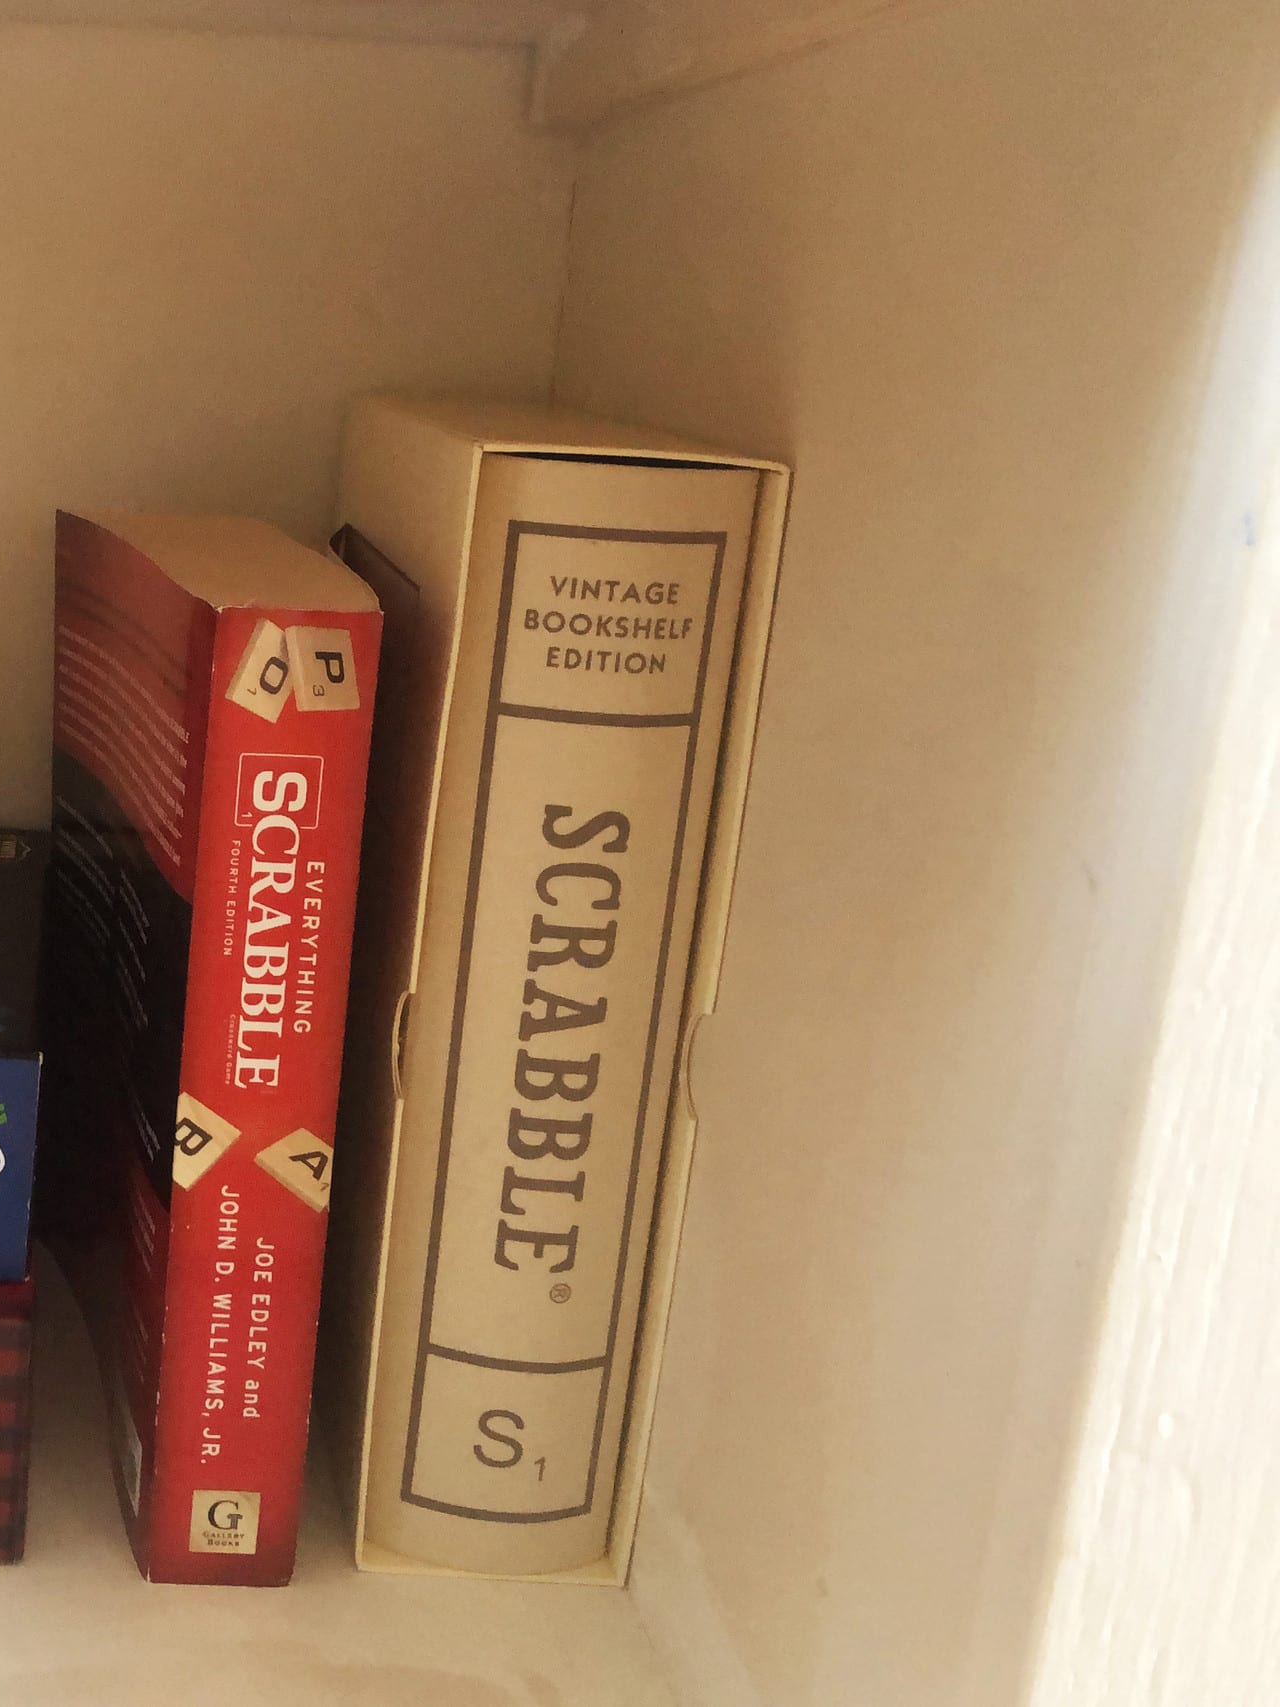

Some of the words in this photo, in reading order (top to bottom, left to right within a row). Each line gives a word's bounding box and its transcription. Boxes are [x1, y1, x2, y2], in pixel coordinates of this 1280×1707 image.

[550, 575, 680, 605] VINTAGE
[524, 608, 693, 640] BOOKSHELF
[314, 651, 345, 684] P
[546, 646, 666, 674] EDITION
[312, 684, 325, 697] 3
[241, 811, 253, 820] 1
[228, 840, 241, 894] FOURTH
[223, 901, 236, 956] EDITION
[234, 771, 308, 1089] SCRABBLE
[293, 861, 326, 1034] EVERYTHING
[175, 1117, 213, 1156] B
[288, 1150, 329, 1181] A
[217, 1185, 240, 1250] JOHN
[214, 1262, 235, 1283] D.
[253, 1237, 274, 1283] JOE
[247, 1293, 271, 1369] EDLEY
[201, 1293, 233, 1417] WILLIAMS,
[243, 1379, 260, 1419] and
[200, 1427, 222, 1464] JR.
